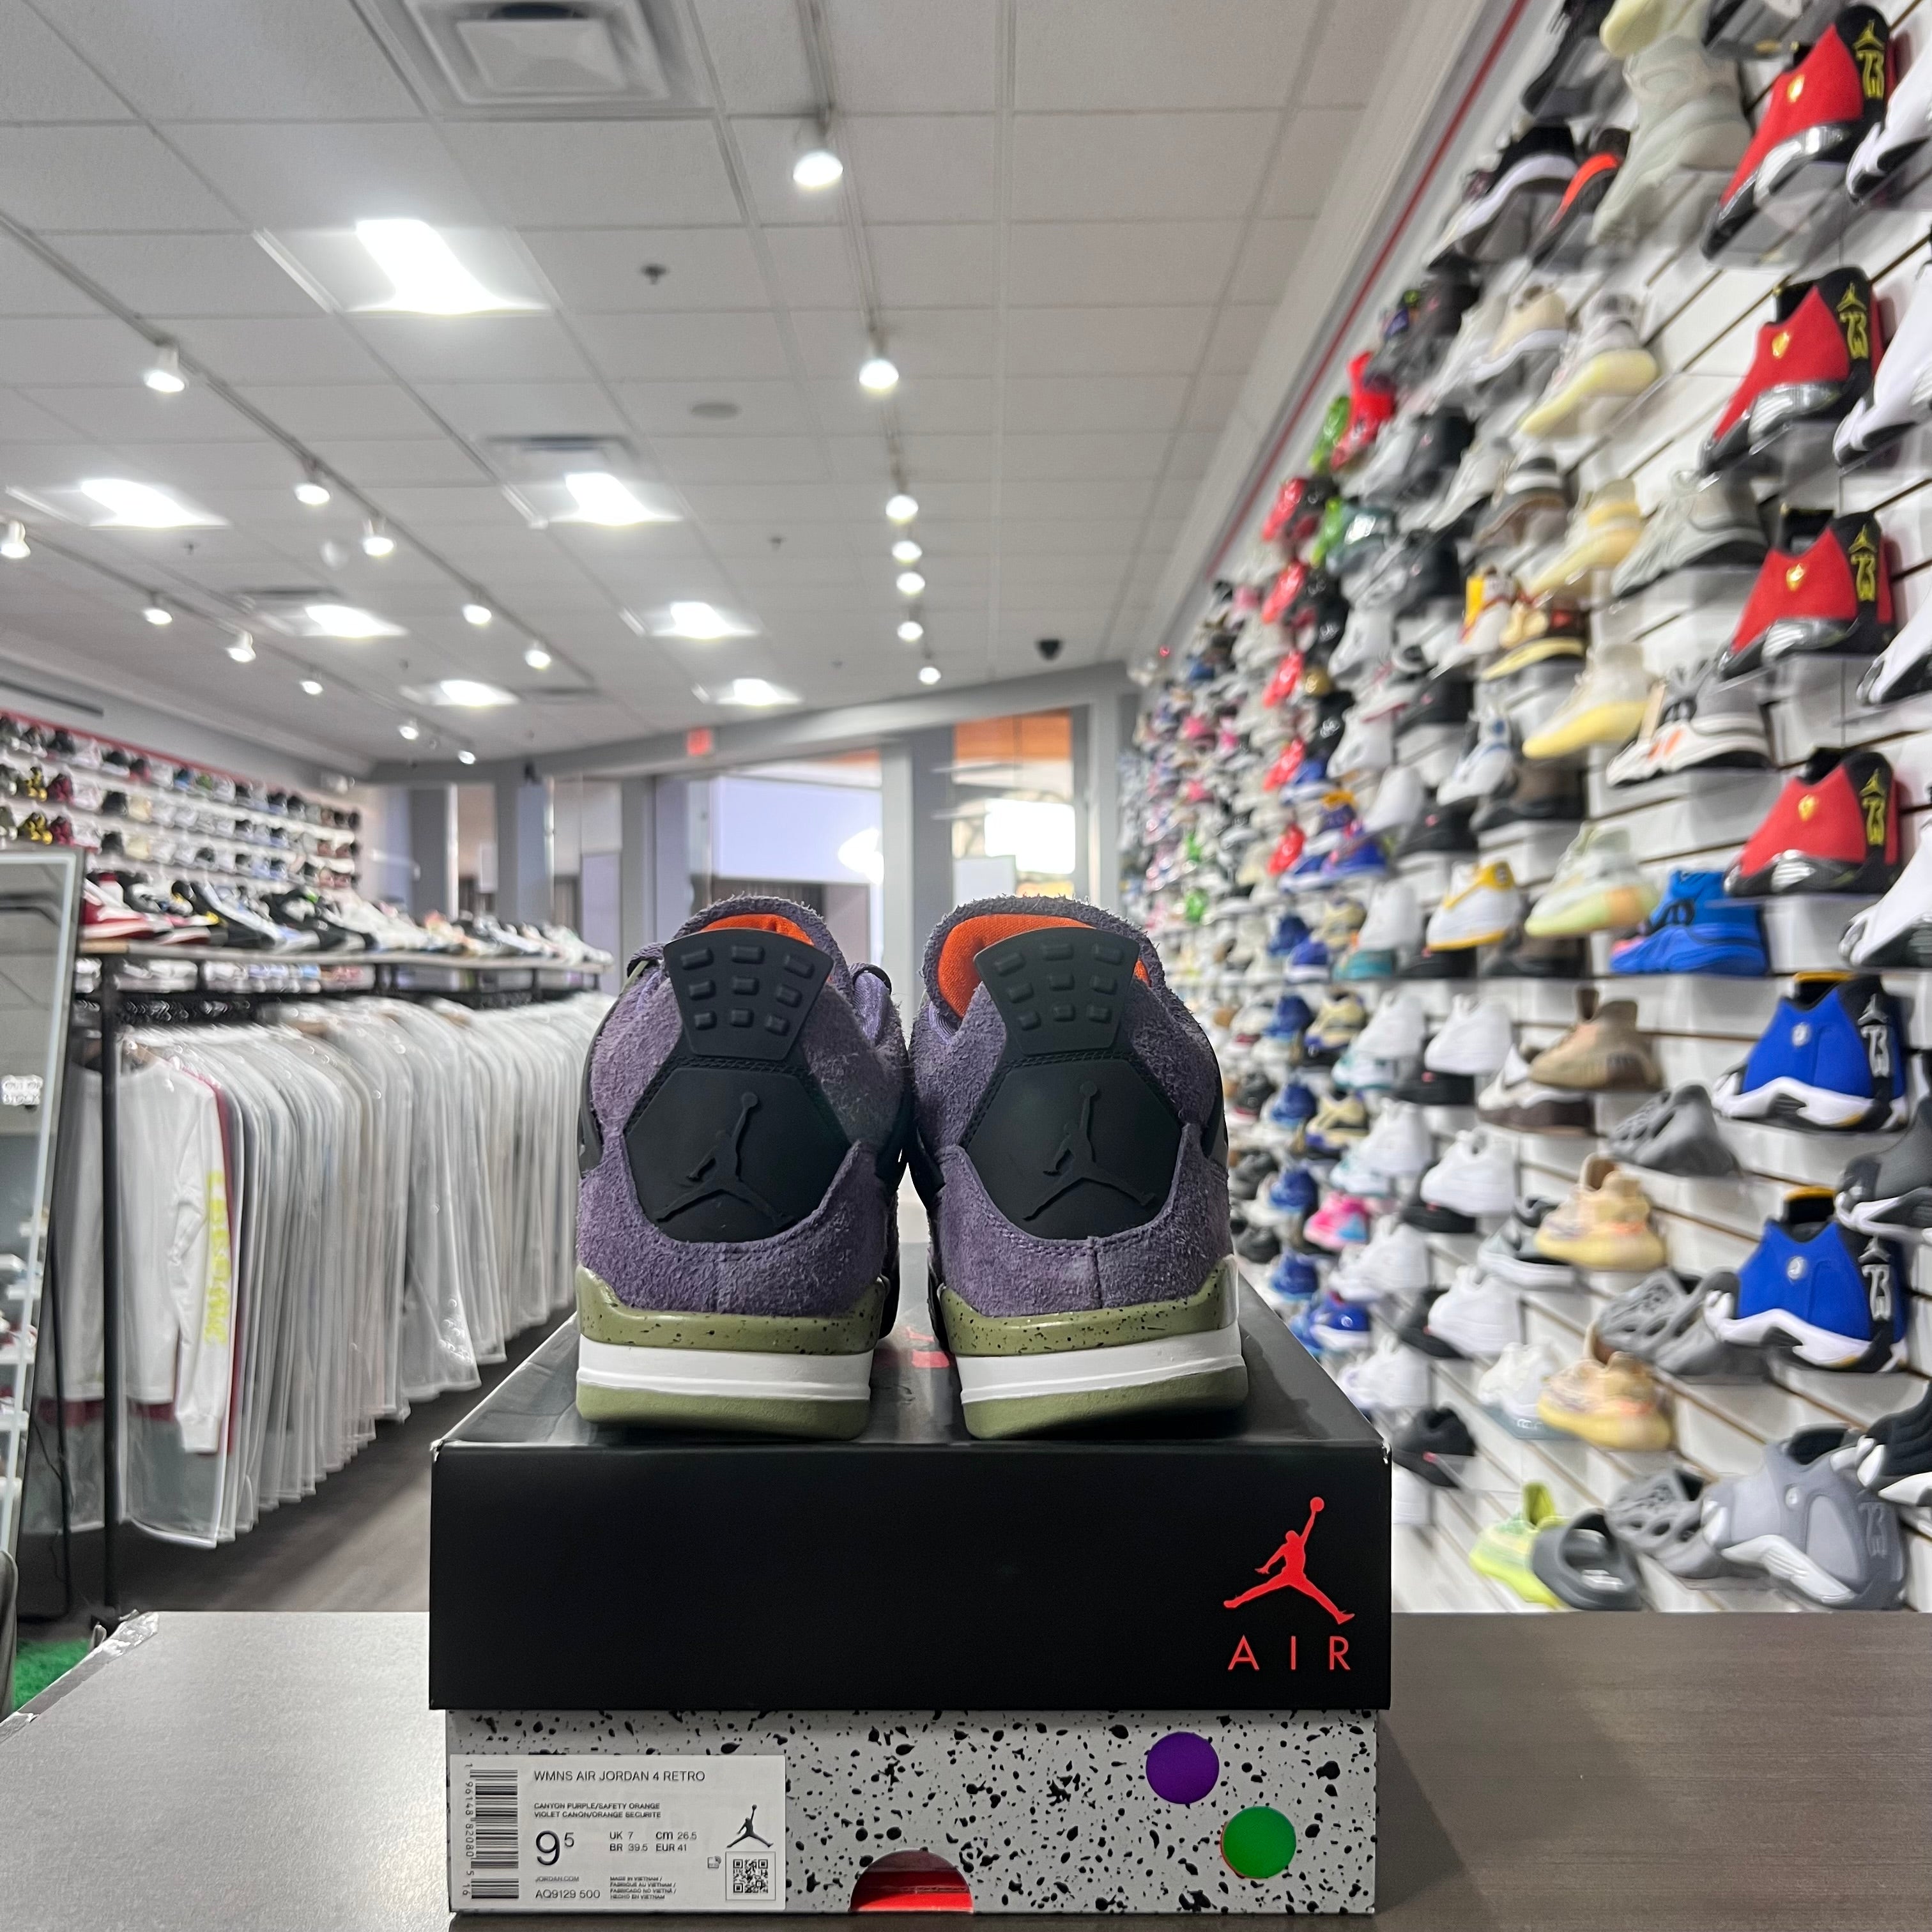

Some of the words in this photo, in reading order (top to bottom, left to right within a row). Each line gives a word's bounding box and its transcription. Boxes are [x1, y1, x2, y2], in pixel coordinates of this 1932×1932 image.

[1227, 1634, 1351, 1671] AIR
[534, 1770, 573, 1781] WMNS
[576, 1770, 595, 1781] AIR
[599, 1770, 649, 1781] JORDAN
[652, 1770, 659, 1781] 4
[663, 1770, 705, 1781] RETRO
[610, 1832, 623, 1840] UK
[628, 1832, 634, 1840] 7
[656, 1832, 673, 1840] cm
[677, 1832, 697, 1840] 26.5
[535, 1889, 576, 1899] AQ9129
[579, 1889, 601, 1899] 500
